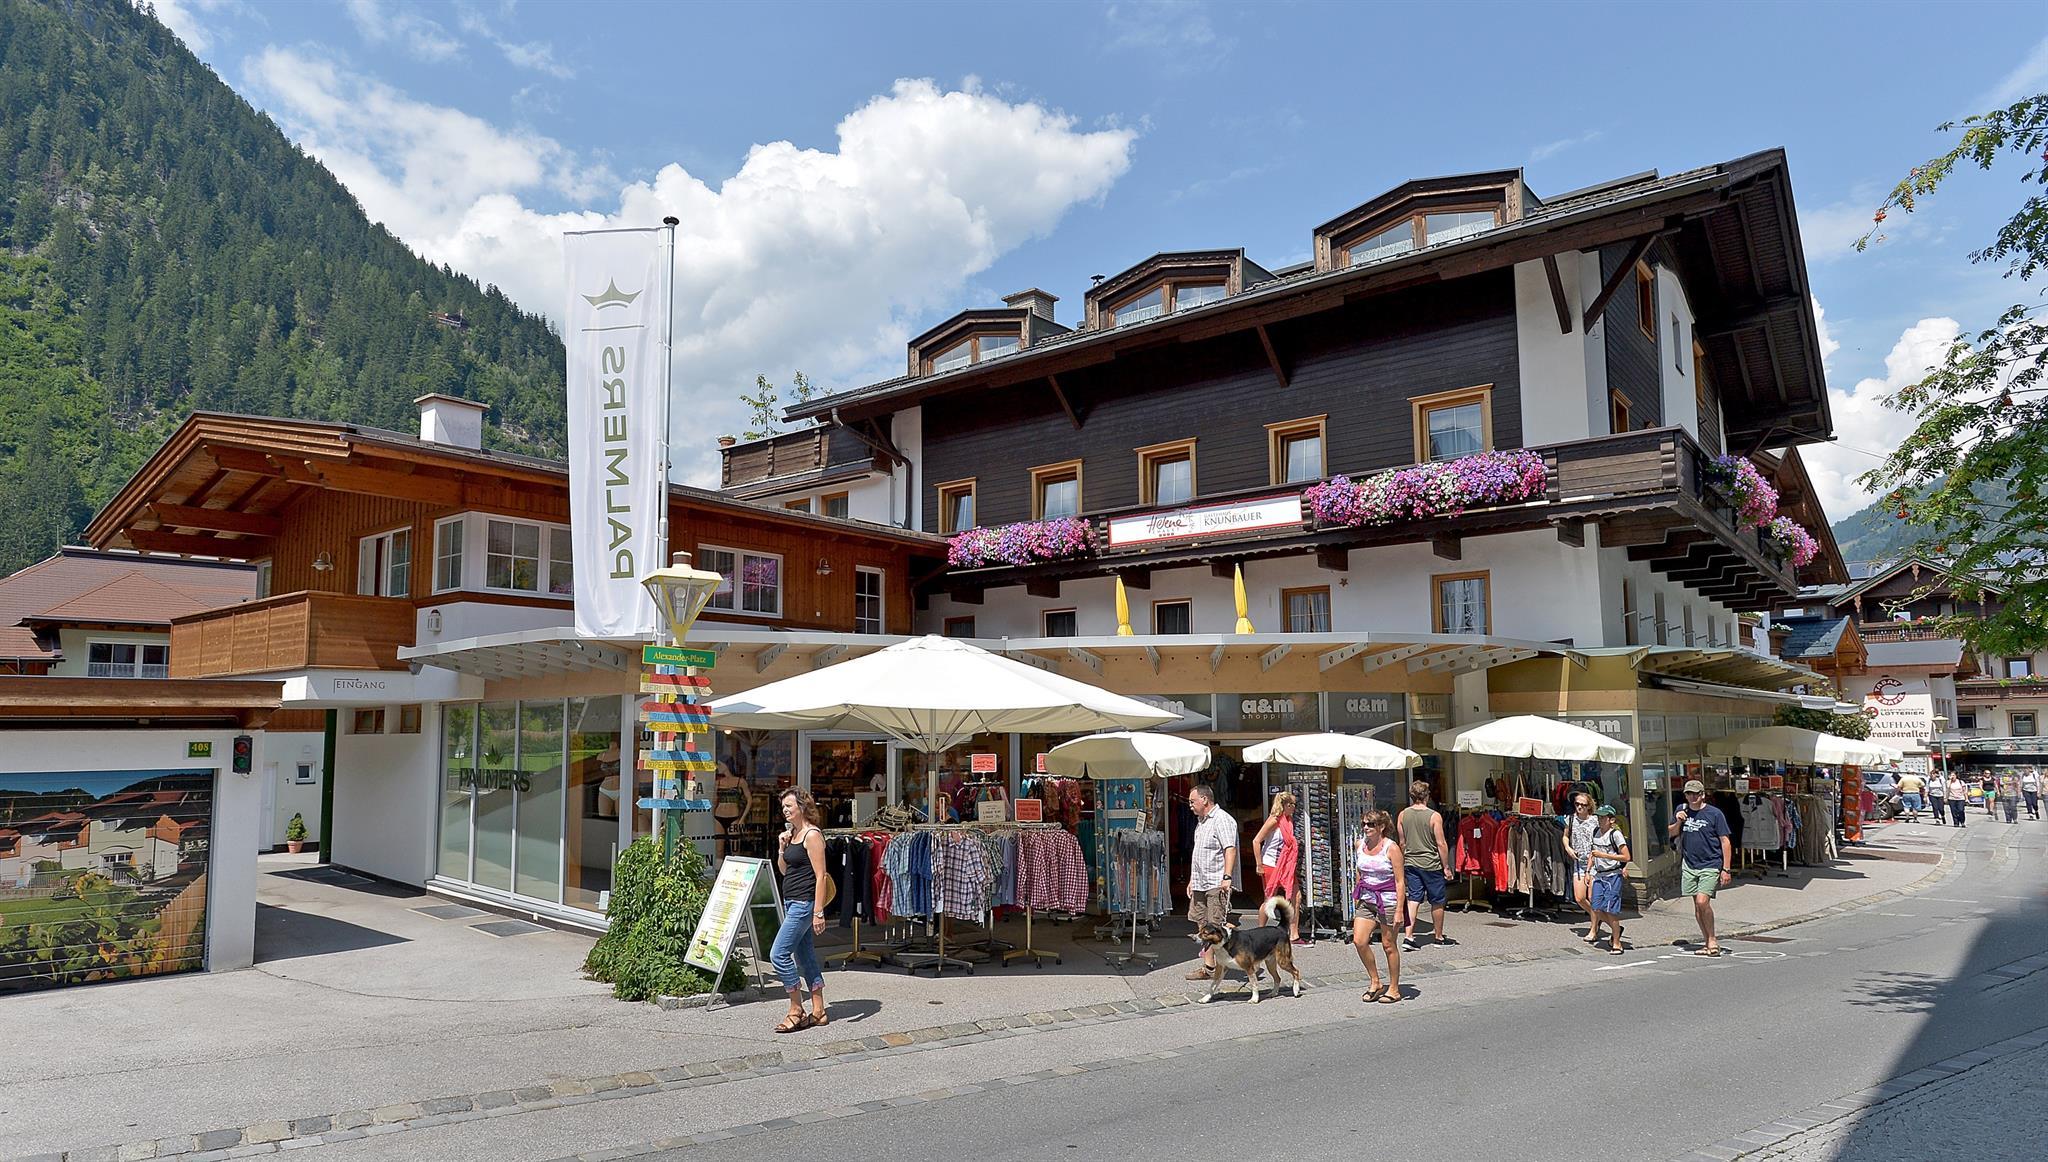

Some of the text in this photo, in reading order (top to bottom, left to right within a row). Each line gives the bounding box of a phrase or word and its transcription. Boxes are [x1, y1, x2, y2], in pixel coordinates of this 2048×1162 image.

[1147, 515, 1188, 533] Helene
[1204, 512, 1262, 526] KNUNBAUER
[653, 652, 706, 663] Alexander-Platz
[336, 680, 385, 689] EINGANG
[1875, 680, 1899, 692] TABAK
[1242, 698, 1294, 713] a&m
[1346, 698, 1388, 713] a&m
[191, 743, 209, 753] 408
[460, 768, 530, 792] PALMERS
